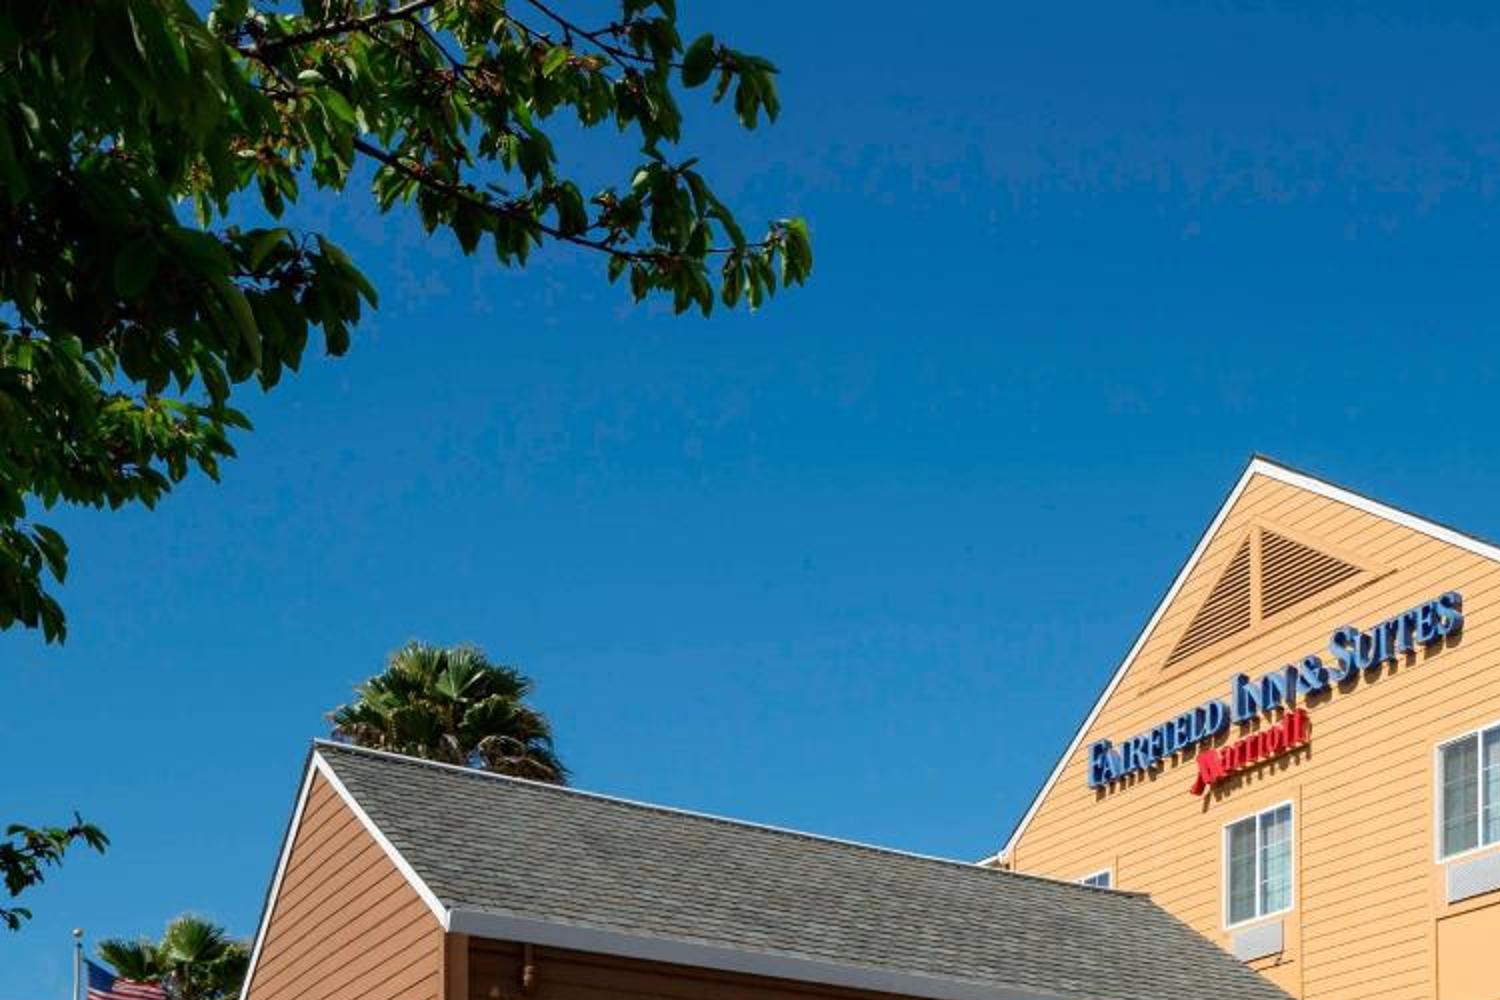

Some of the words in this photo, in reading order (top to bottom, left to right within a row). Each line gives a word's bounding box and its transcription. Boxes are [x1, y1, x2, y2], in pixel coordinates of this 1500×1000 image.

[1088, 699, 1230, 789] FAIRFIELD
[1328, 590, 1463, 682] SUITES
[1190, 707, 1309, 795] Marriott
